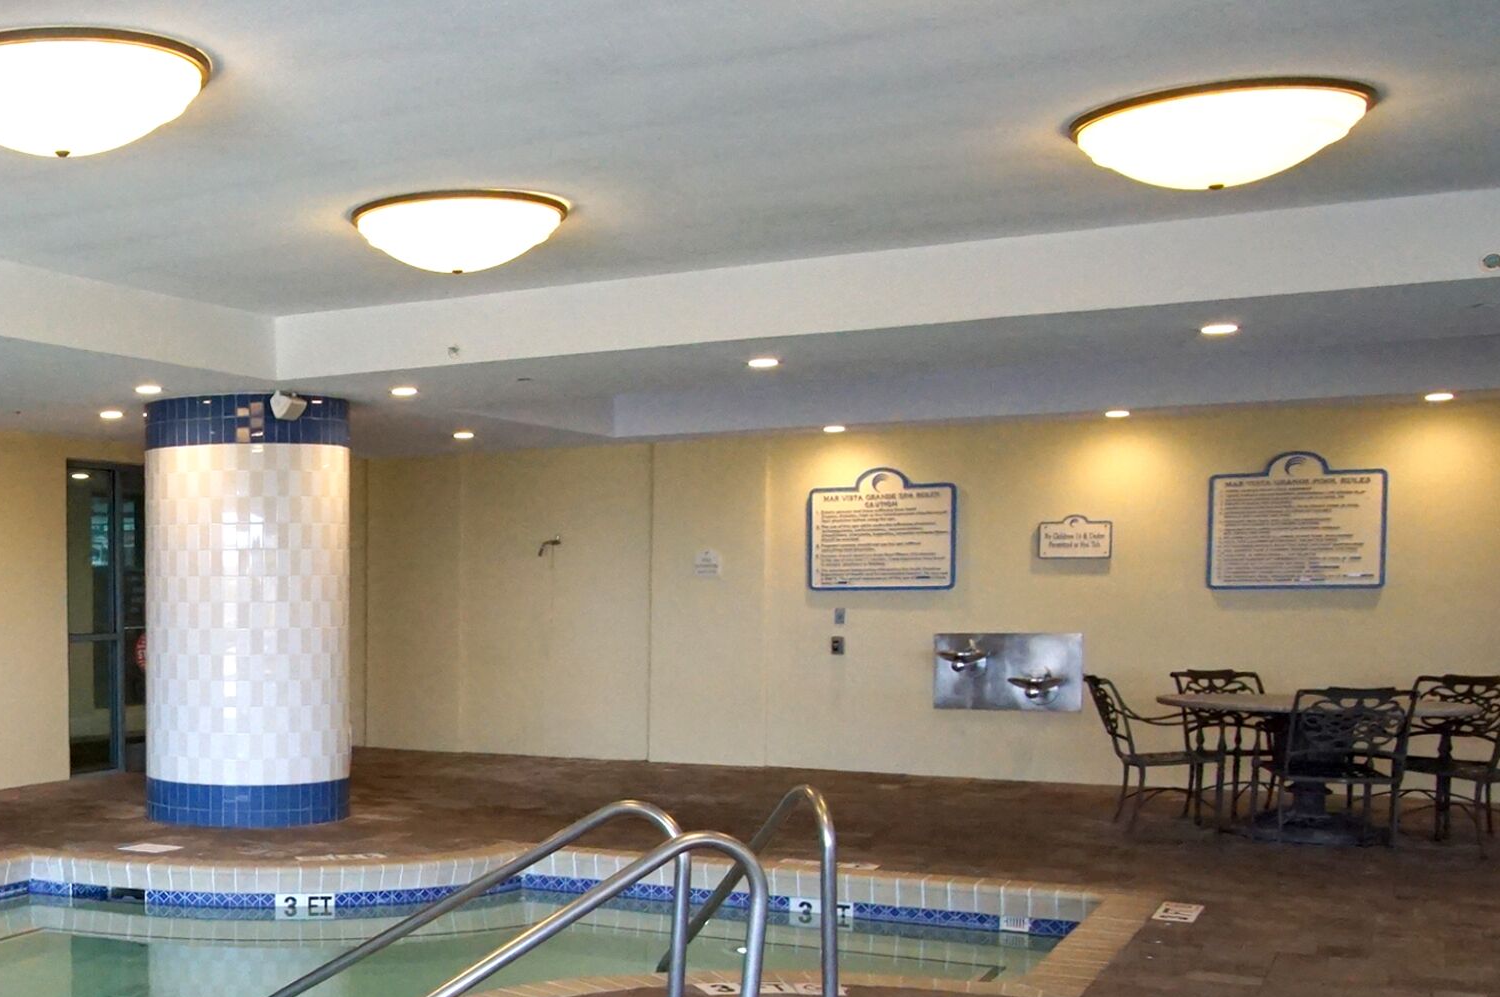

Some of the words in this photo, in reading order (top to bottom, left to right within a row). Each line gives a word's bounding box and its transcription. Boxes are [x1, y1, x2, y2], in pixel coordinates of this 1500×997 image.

[284, 896, 298, 914] 3
[307, 896, 333, 913] FT
[798, 901, 813, 920] 3
